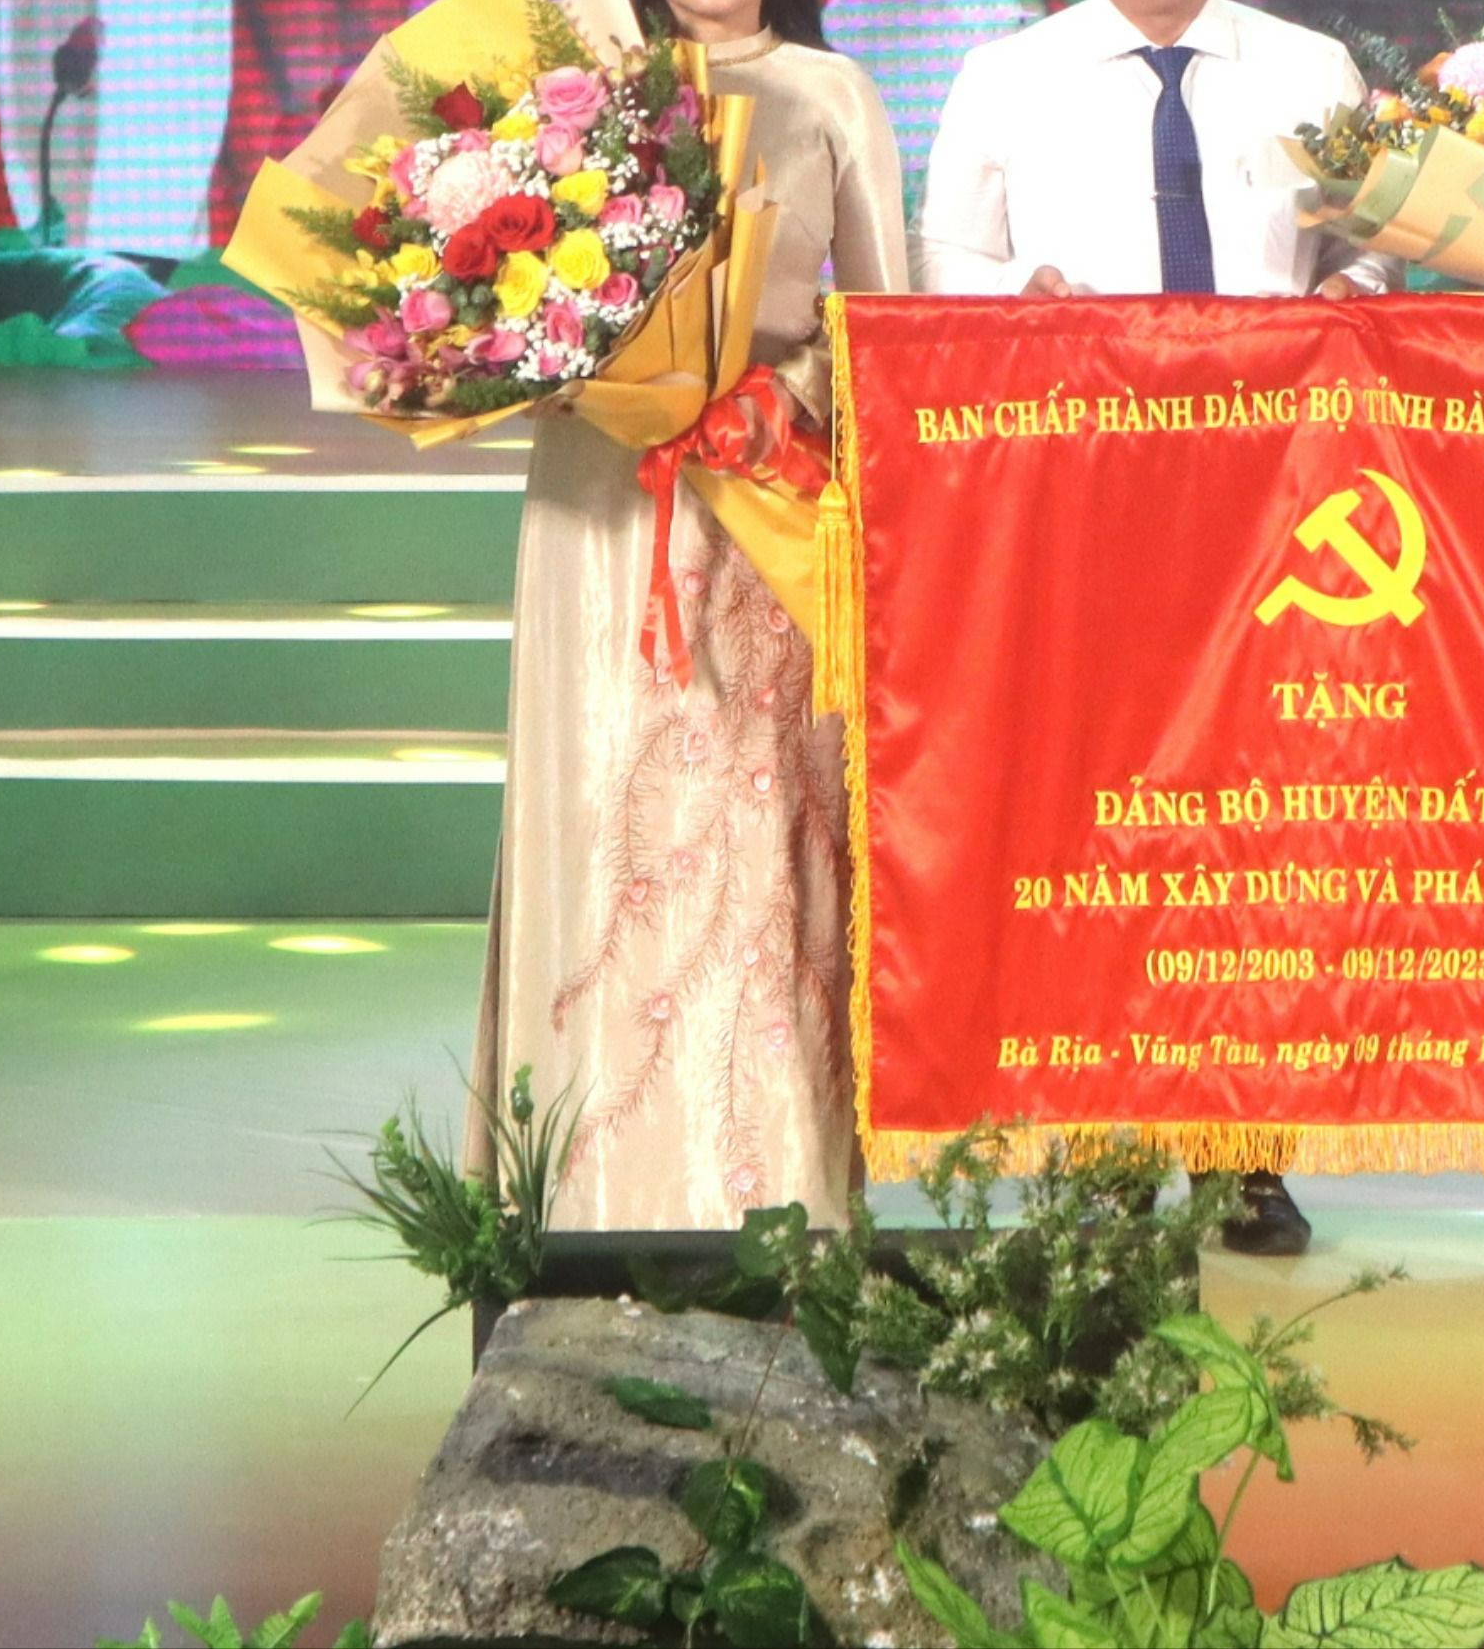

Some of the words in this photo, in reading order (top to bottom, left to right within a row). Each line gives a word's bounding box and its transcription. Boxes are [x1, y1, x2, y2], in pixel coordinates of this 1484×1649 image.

[915, 405, 984, 443] BAN
[994, 382, 1087, 438] CHẤP
[1096, 387, 1194, 432] HÀNH
[1203, 380, 1298, 428] ĐẢNG
[1308, 377, 1354, 432] BỘ
[1362, 376, 1434, 430] TỈNH
[1272, 671, 1407, 729] TẶNG
[1094, 775, 1207, 826] ĐẢNG
[1217, 777, 1270, 832] BỘ
[1281, 775, 1408, 830] HUYỆN
[1014, 877, 1052, 909] 20
[1063, 864, 1149, 907] NĂM
[1161, 864, 1235, 907] XÂY
[1244, 862, 1347, 911] DỰNG
[1355, 857, 1400, 903] VÀ
[1146, 948, 1315, 986] (09/12/2003
[997, 1037, 1039, 1068] Bà
[1048, 1035, 1102, 1073] Rịa
[1130, 1033, 1202, 1073] Vũng
[1210, 1035, 1266, 1068] Tàu,
[1276, 1035, 1350, 1071] ngày
[1353, 1034, 1379, 1064] 09
[1386, 1030, 1469, 1067] tháng
